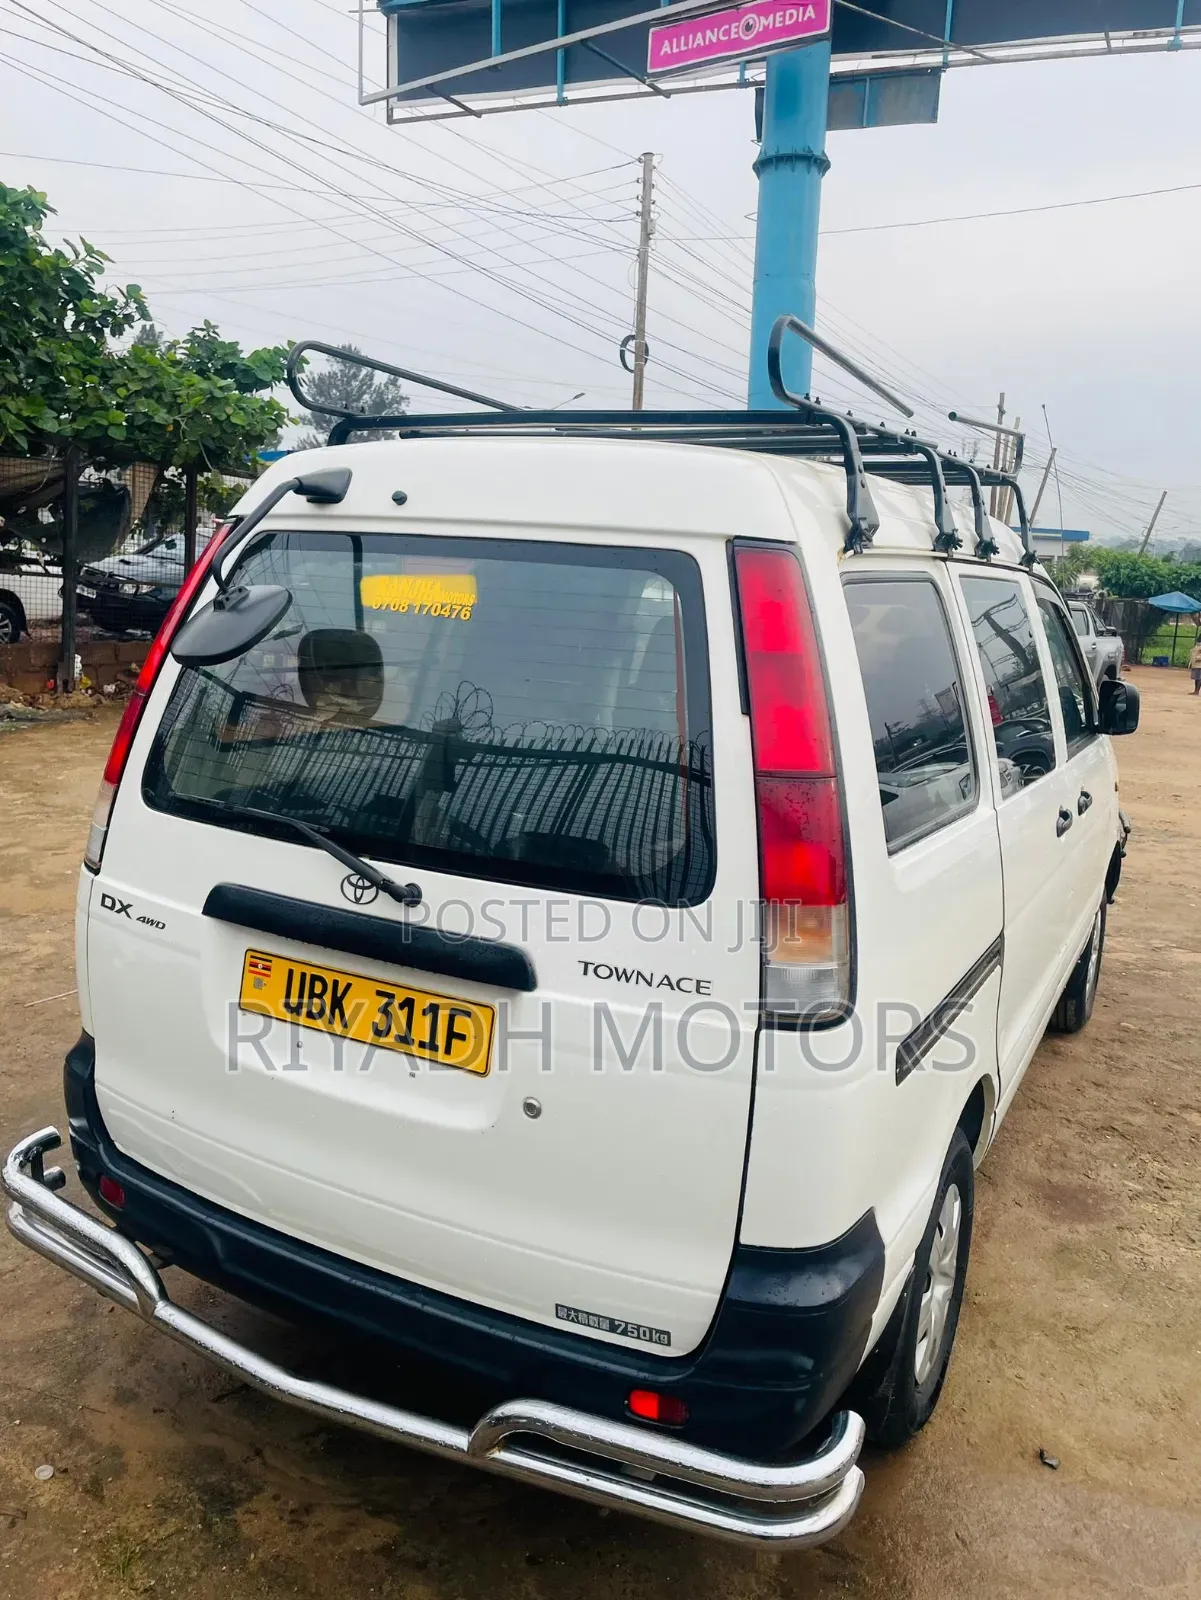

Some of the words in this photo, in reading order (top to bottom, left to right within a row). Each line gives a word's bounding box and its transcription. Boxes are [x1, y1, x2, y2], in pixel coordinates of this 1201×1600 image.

[660, 24, 740, 56] ALLIANCE
[758, 4, 816, 32] MEDIA
[413, 600, 472, 620] 170476
[100, 892, 133, 920] DX
[136, 916, 166, 930] 4WD
[283, 967, 353, 1029] UBK
[371, 989, 472, 1056] 311F
[614, 1319, 668, 1345] 750kg
